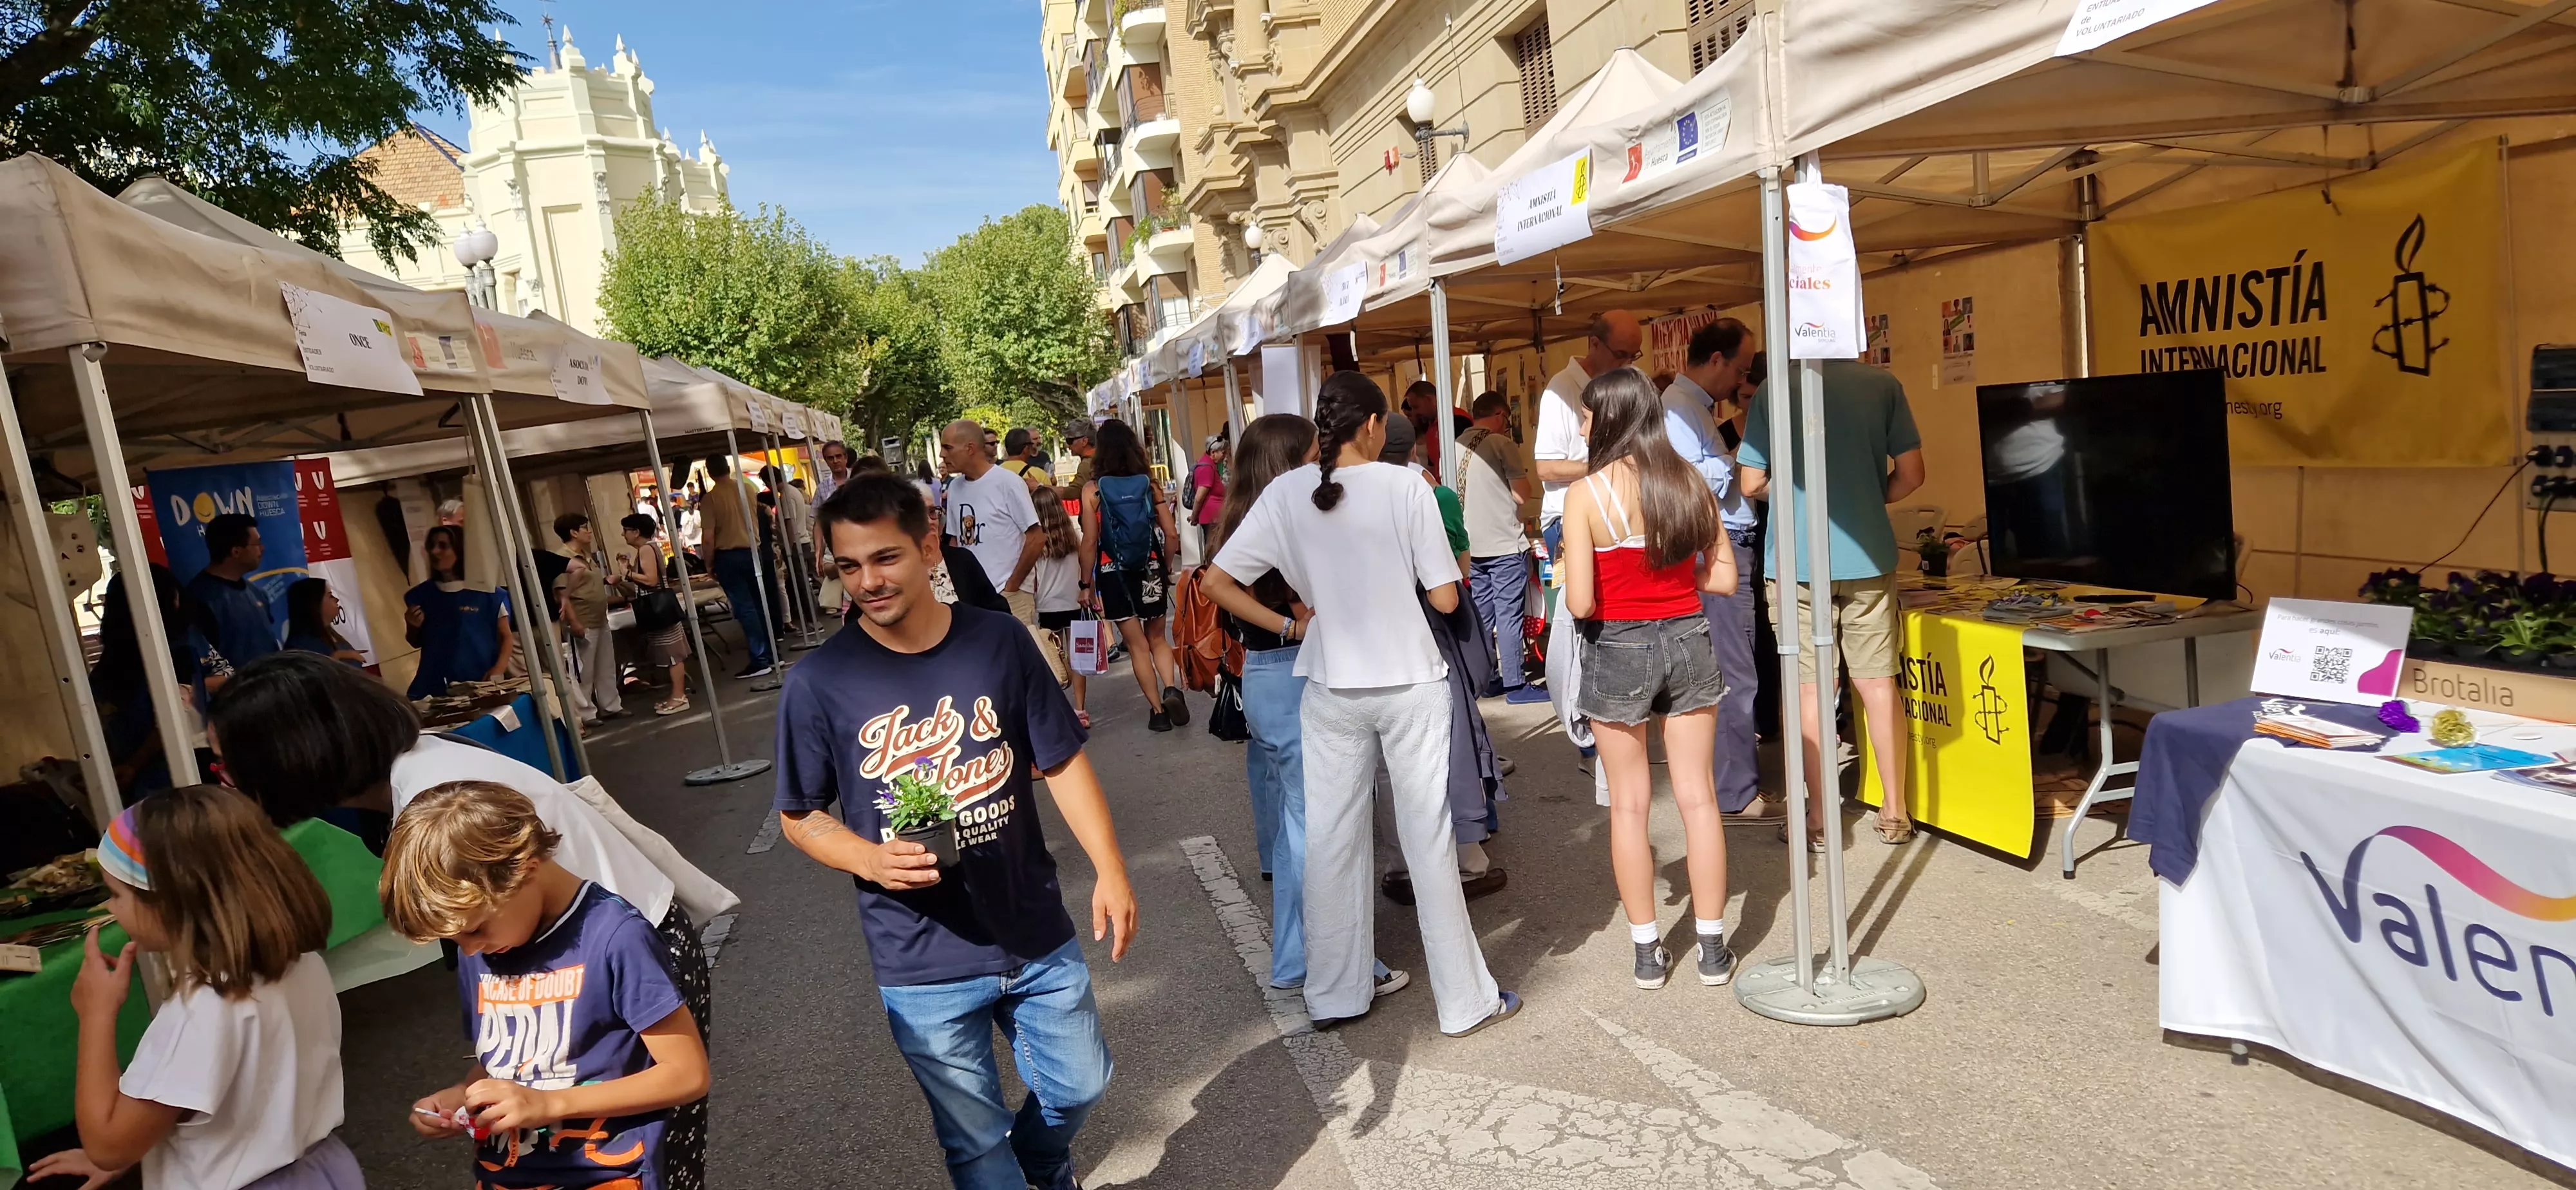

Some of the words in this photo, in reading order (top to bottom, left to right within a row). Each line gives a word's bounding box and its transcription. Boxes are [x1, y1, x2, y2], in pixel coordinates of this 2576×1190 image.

[2076, 8, 2145, 37] VOLUNTARIADO
[2081, 16, 2091, 24] de
[1517, 205, 1563, 232] INTERNACIONAL
[2139, 249, 2327, 337] AMNISTÍA
[348, 332, 373, 350] ONCE
[1795, 322, 1835, 338] Valentia
[2141, 336, 2327, 379] INTERNACIONAL
[2269, 648, 2301, 663] Valentia
[2413, 668, 2514, 707] Brotalia
[858, 695, 965, 784] Jack
[970, 695, 1001, 742] &
[912, 741, 1014, 810] Jones
[959, 795, 1015, 827] GOODS
[963, 815, 1009, 837] QUALITY
[969, 832, 998, 845] WEAR
[535, 967, 584, 1000] DOUBT
[475, 999, 577, 1081] PEDAL
